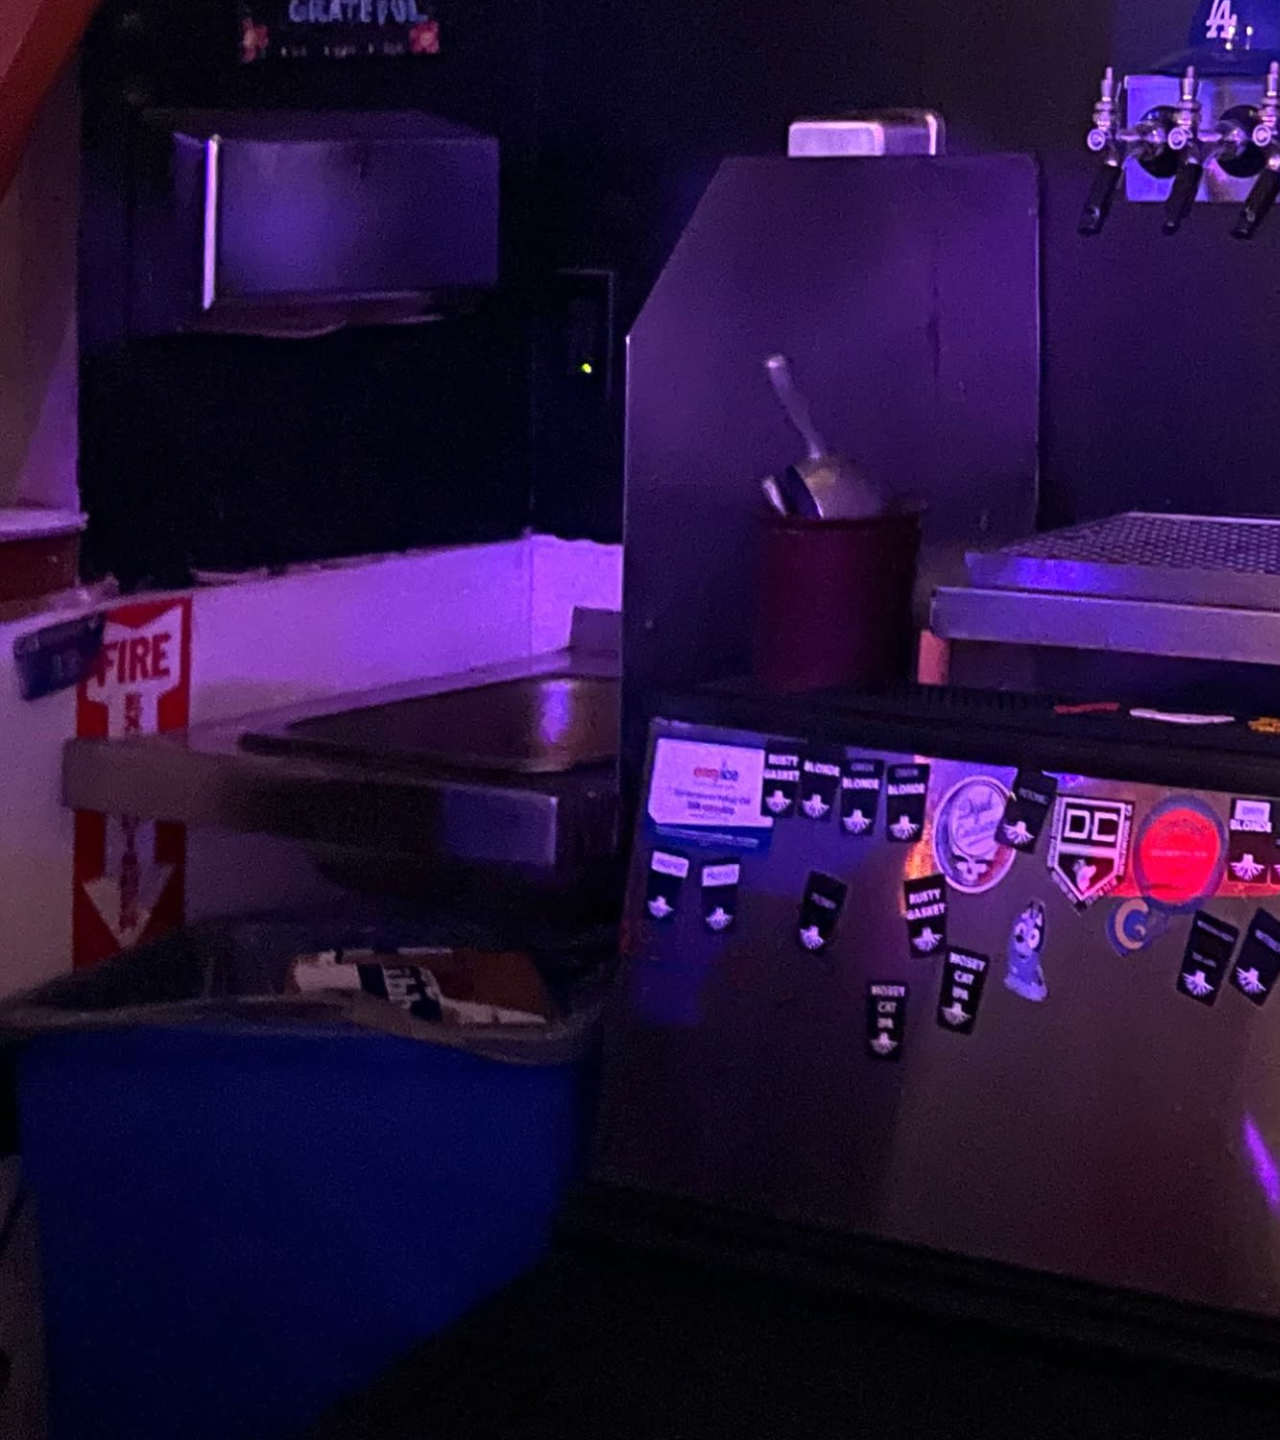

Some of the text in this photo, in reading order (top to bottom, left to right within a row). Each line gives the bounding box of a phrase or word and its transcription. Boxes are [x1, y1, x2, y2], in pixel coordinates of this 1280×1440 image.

[97, 632, 173, 687] FIRE
[803, 760, 841, 777] BLONDE
[841, 777, 880, 790] BLONDE
[887, 783, 926, 796] BLONDE
